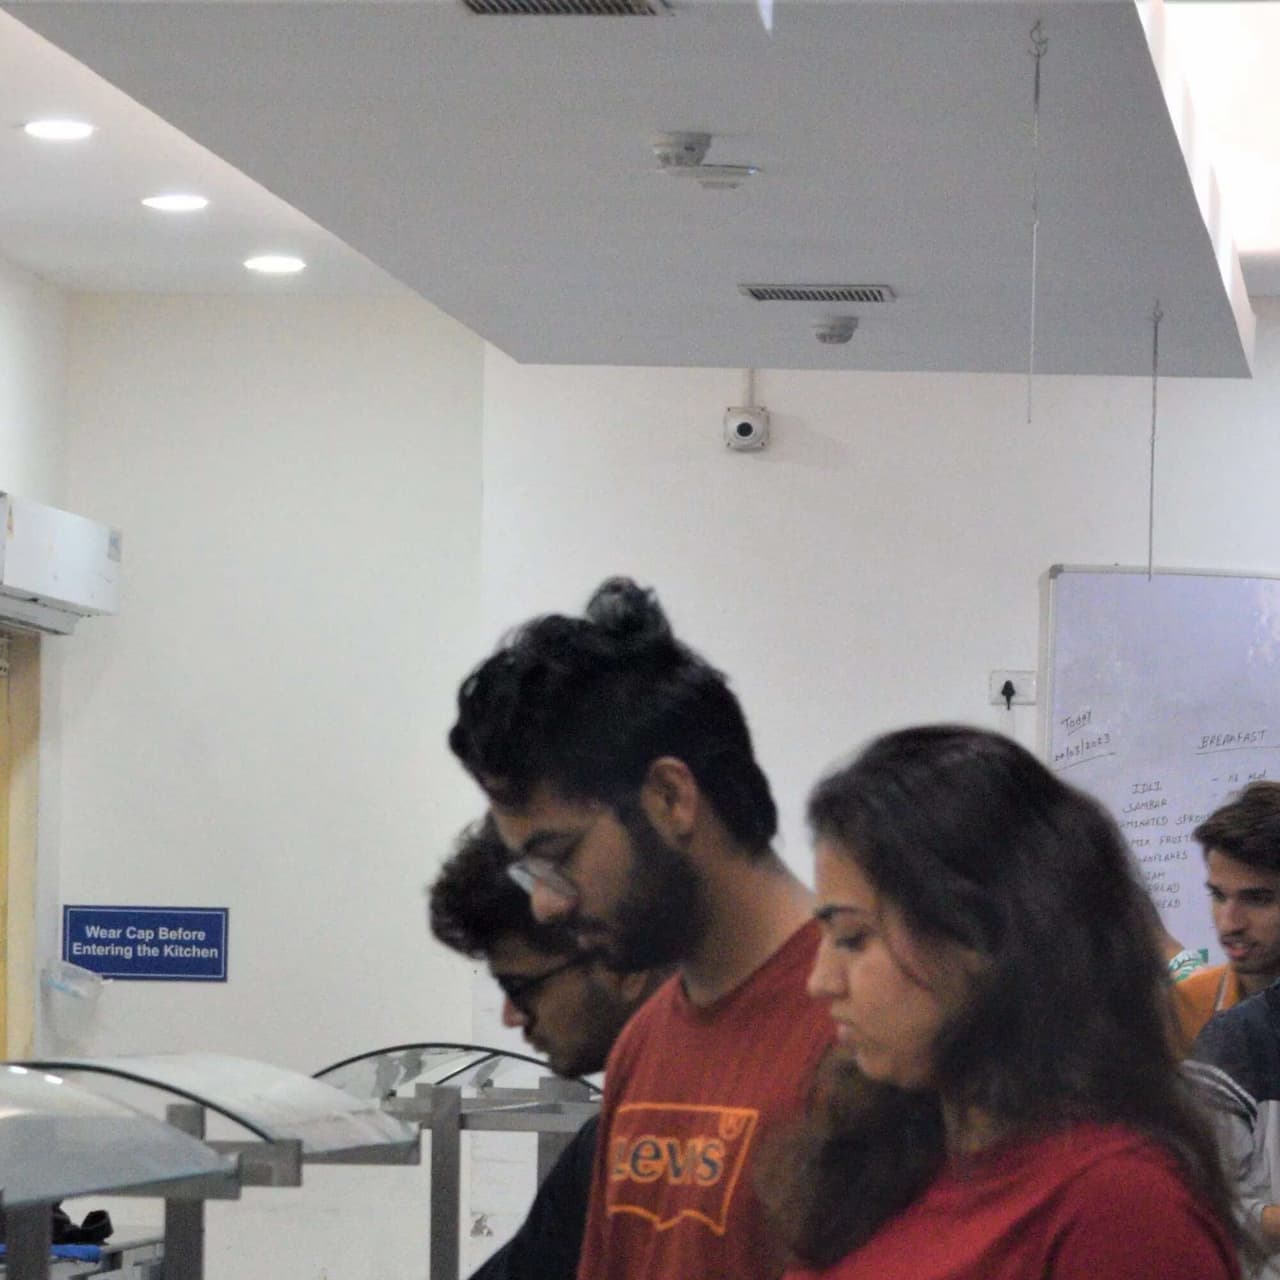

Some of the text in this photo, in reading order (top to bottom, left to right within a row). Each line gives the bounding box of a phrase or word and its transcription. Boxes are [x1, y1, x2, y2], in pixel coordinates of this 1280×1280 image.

[1198, 730, 1265, 750] BREAKFAST
[1131, 780, 1162, 795] IDLI
[85, 925, 206, 942] Wear Cap Before
[72, 942, 218, 959] Entering the Kitchen
